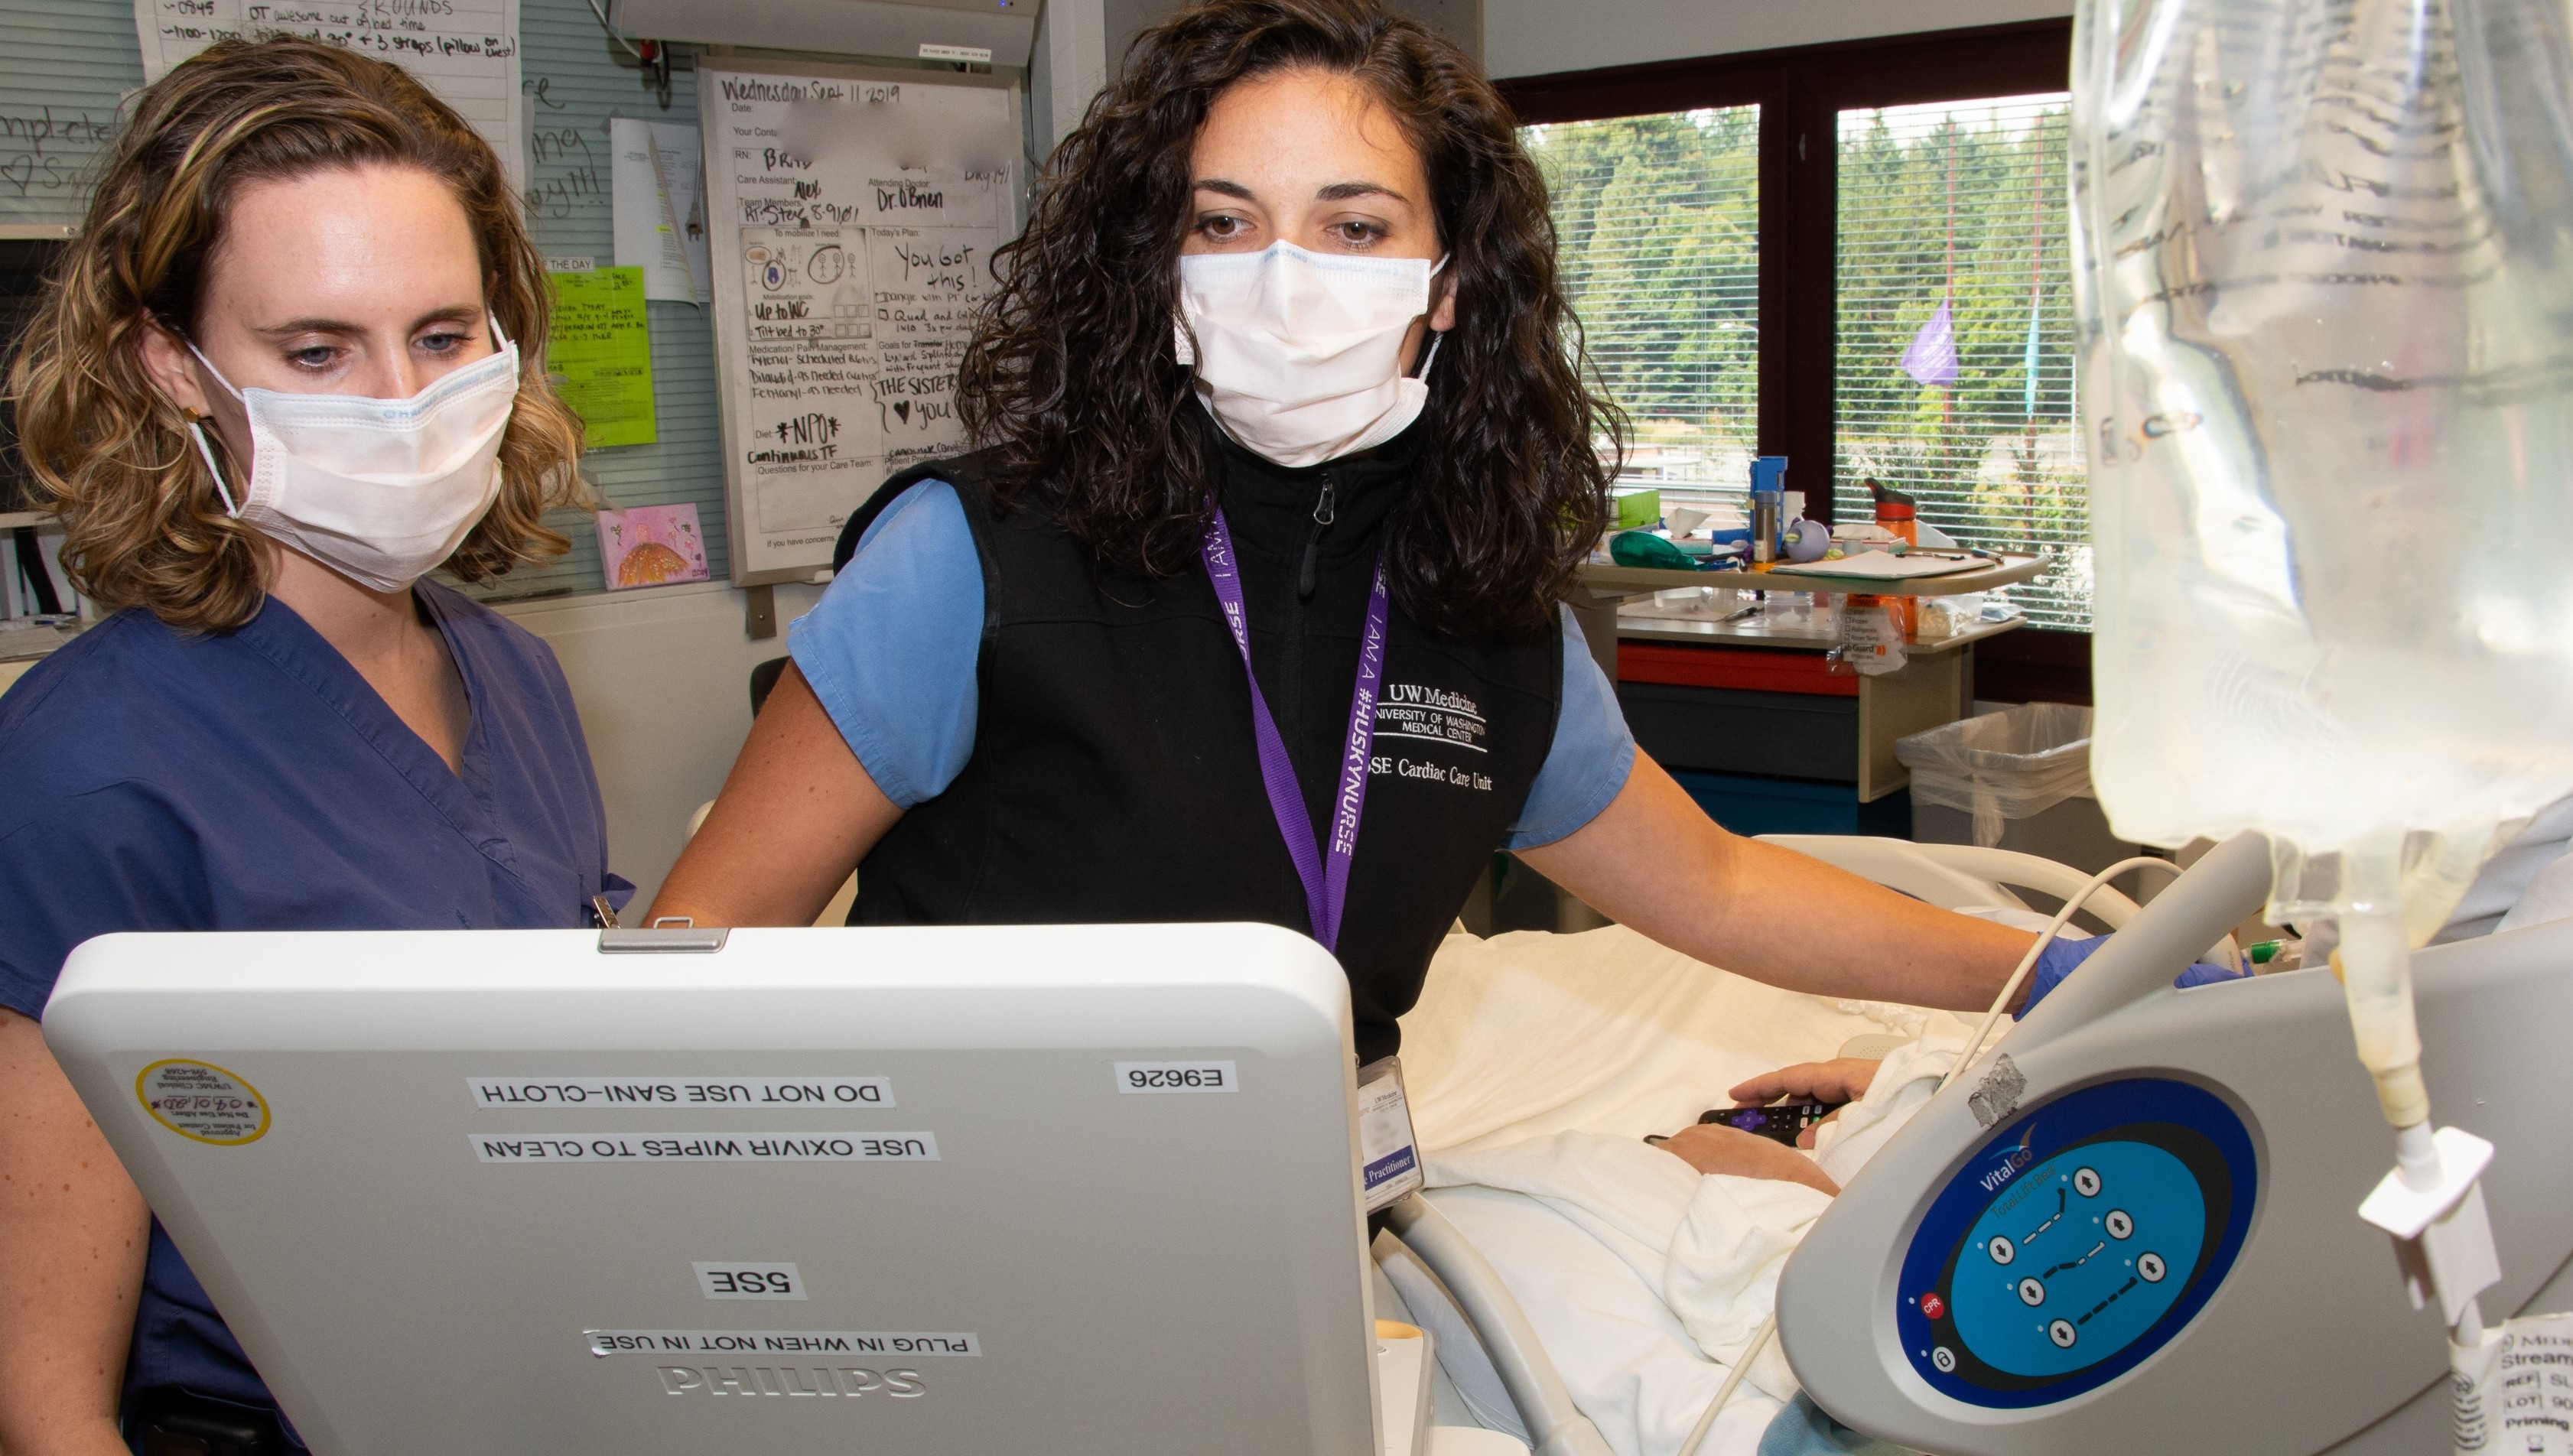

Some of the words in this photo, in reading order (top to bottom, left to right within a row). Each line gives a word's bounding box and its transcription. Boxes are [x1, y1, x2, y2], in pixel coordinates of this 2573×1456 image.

[399, 18, 425, 31] time
[392, 37, 434, 56] straps
[865, 84, 900, 103] 2019
[731, 102, 754, 113] Date:
[733, 125, 752, 137] Your
[737, 175, 757, 184] Care
[867, 178, 903, 189] Attending
[794, 179, 821, 201] Alex
[739, 197, 763, 207] Team
[774, 229, 783, 238] To
[785, 229, 815, 238] mobilize
[871, 228, 900, 239] Today's
[901, 229, 921, 237] Plan:
[551, 260, 570, 269] THE
[572, 260, 591, 269] DAY
[775, 304, 788, 317] to
[788, 301, 810, 320] WC
[894, 309, 927, 322] Quad
[933, 310, 954, 320] and
[776, 324, 793, 337] bed
[795, 325, 808, 336] to
[879, 341, 900, 350] Goals
[902, 341, 912, 349] for
[811, 370, 844, 382] needed
[821, 383, 863, 397] needed
[875, 375, 906, 397] THE
[755, 429, 774, 440] Diet:
[757, 463, 797, 475] Questions
[799, 463, 809, 472] for
[810, 463, 828, 473] your
[829, 460, 848, 470] Care
[850, 459, 873, 469] Team:
[884, 456, 910, 466] Patient
[766, 540, 772, 548] If
[773, 540, 786, 549] you
[1852, 644, 1874, 652] Guard
[1389, 684, 1423, 703] UW
[1424, 687, 1478, 715] Medicine
[1374, 708, 1426, 722] NIVERSITY
[1430, 713, 1443, 724] OF
[1446, 715, 1486, 736] WASHINGTON
[1402, 720, 1444, 736] MEDICAL
[1446, 727, 1472, 743] CENTER
[1335, 687, 1373, 856] #HUSKYNURSE
[1398, 759, 1446, 782] Cardiac
[1449, 766, 1470, 787] Care
[1473, 772, 1493, 791] Unit
[161, 1074, 218, 1082] Engineering
[1129, 1069, 1223, 1088] E9626
[194, 1082, 232, 1090] UWMC
[480, 1085, 678, 1102] SANI-CLOTH
[685, 1085, 752, 1102] USE
[761, 1085, 825, 1102] NOT
[834, 1085, 880, 1102] DO
[200, 1128, 241, 1137] Approved
[483, 1141, 584, 1157] CLEAN
[592, 1140, 636, 1156] TO
[642, 1140, 743, 1156] WIPES
[748, 1139, 854, 1156] OXIVIR
[860, 1139, 926, 1156] USE
[1368, 1153, 1411, 1183] Practitioner
[1979, 1149, 2032, 1191] VitalGo
[1990, 1191, 2018, 1219] Total
[2018, 1181, 2035, 1200] Lift
[2034, 1165, 2056, 1187] Bed
[707, 1271, 792, 1293] 5SE
[1924, 1298, 1940, 1314] CPR
[597, 1335, 654, 1350] USE
[661, 1335, 691, 1350] IN
[700, 1335, 758, 1350] NOT
[764, 1336, 851, 1350] WHEN
[857, 1337, 885, 1351] IN
[893, 1337, 970, 1352] PLUG
[656, 1365, 927, 1398] PHILIPS
[2505, 1417, 2570, 1432] Priming
